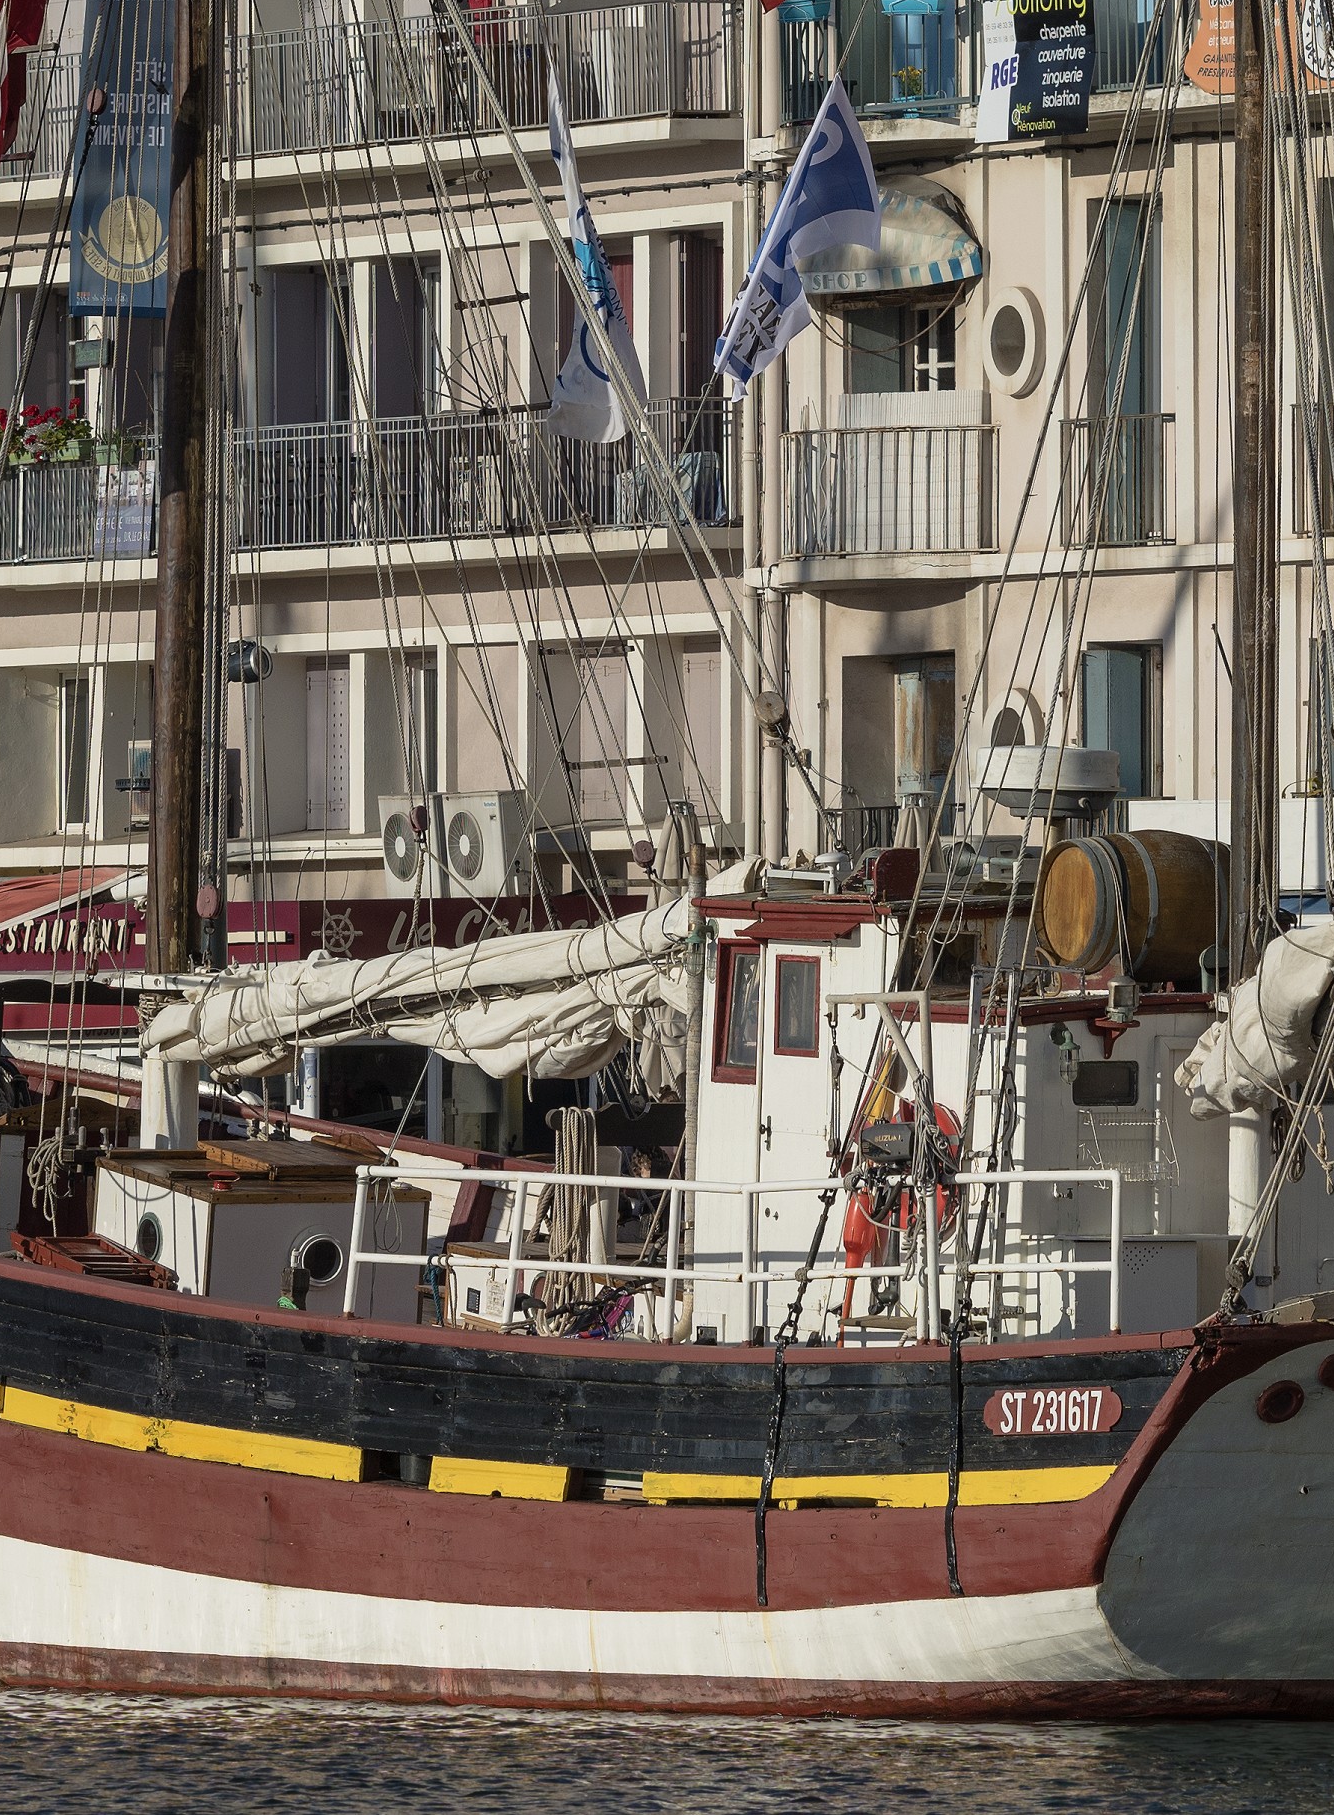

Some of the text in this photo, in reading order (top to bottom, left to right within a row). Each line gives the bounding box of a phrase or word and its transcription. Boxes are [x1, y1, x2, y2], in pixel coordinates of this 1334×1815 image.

[1039, 20, 1087, 42] charpente
[1038, 45, 1086, 63] couverture
[991, 55, 1019, 90] RGE
[1042, 66, 1084, 87] zinguerie
[1016, 102, 1032, 115] Neuf
[1042, 90, 1081, 108] isolation
[1017, 119, 1056, 132] Rénovation
[813, 272, 868, 290] SHOP
[387, 909, 437, 954] Le
[999, 1389, 1104, 1434] ST 231617
